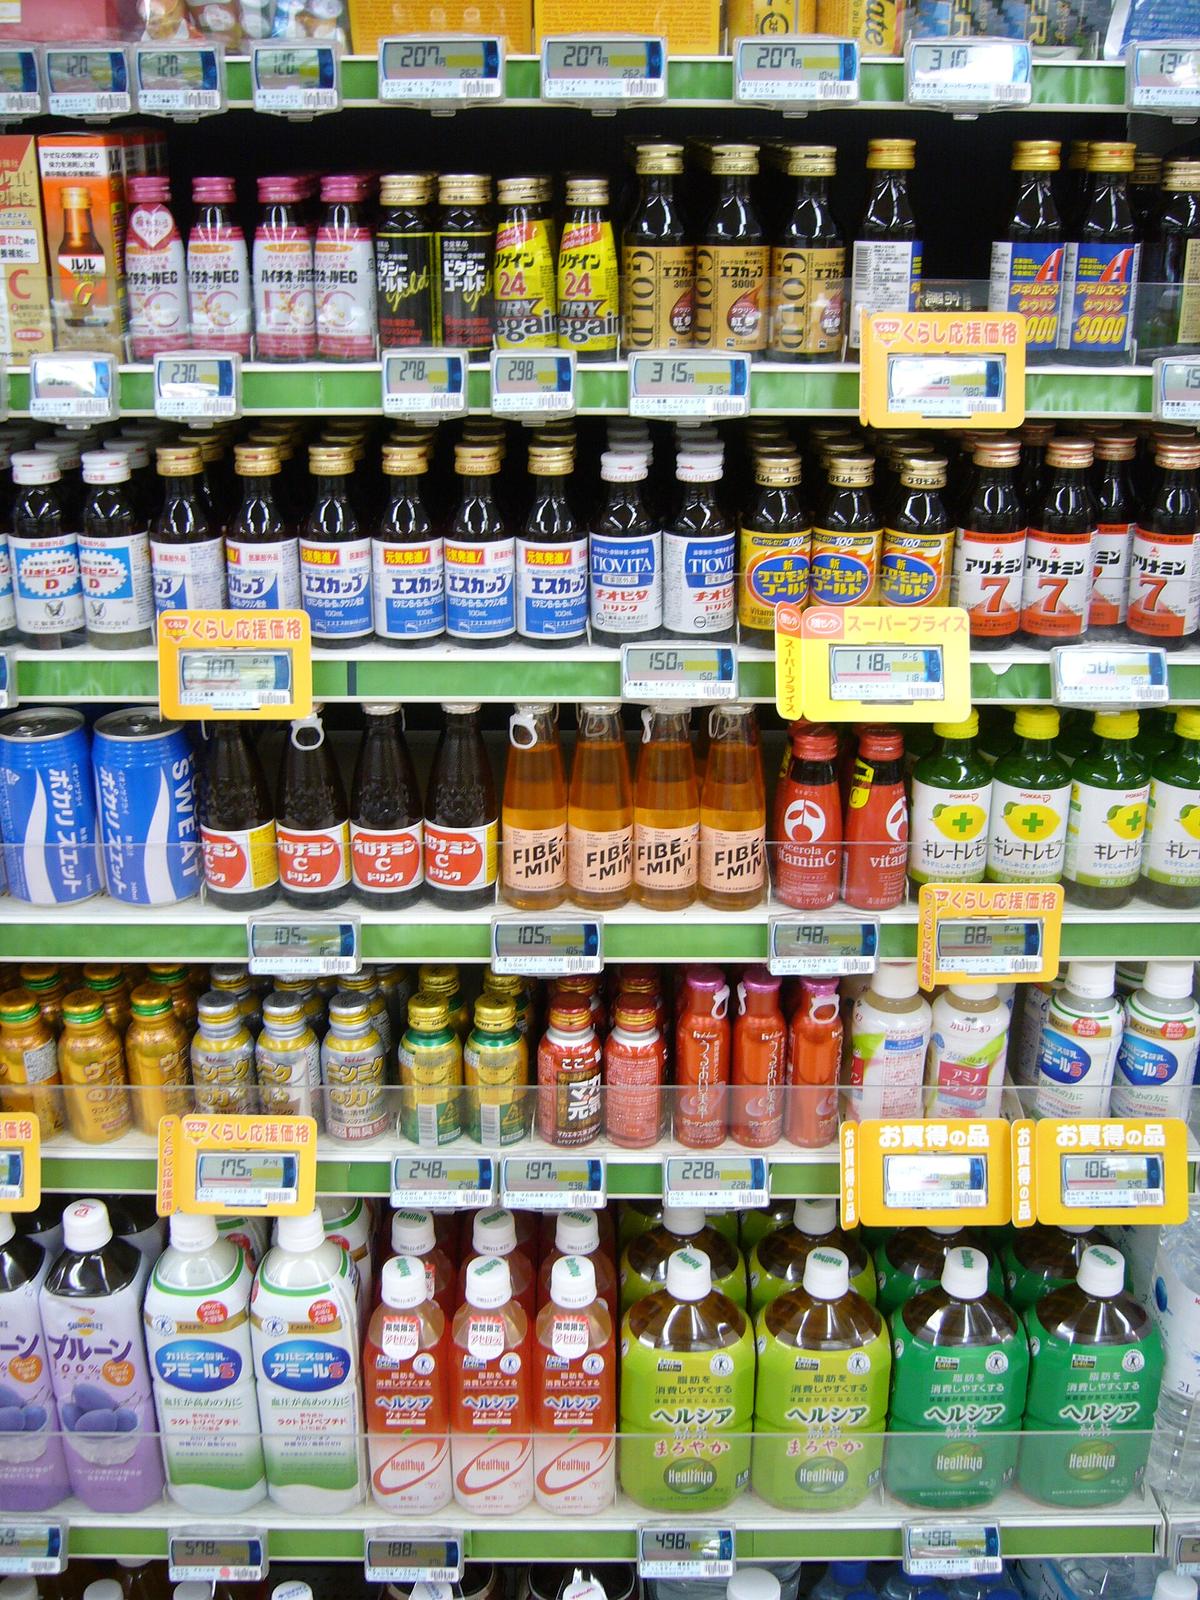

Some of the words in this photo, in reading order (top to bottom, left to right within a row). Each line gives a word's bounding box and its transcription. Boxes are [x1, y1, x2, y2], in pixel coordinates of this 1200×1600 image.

[71, 258, 96, 269] ルル
[444, 260, 485, 276] ビタシー
[498, 271, 526, 297] 24
[565, 271, 592, 297] 24
[903, 323, 1017, 345] くらし応援価格
[1073, 315, 1128, 345] 3000
[24, 565, 75, 577] リポビタン
[592, 554, 652, 573] TIOVITA
[965, 557, 1022, 576] アリナミン
[1027, 556, 1084, 576] アリナミン
[45, 579, 59, 590] D
[89, 579, 100, 589] D
[305, 574, 363, 594] エスカップ
[449, 574, 506, 594] エスカップ
[595, 590, 649, 601] チオビタ
[981, 576, 1010, 614] 7
[1037, 576, 1069, 614] 7
[1139, 574, 1168, 613] 7
[603, 604, 638, 612] ドリンク
[192, 620, 302, 640] くらし応援価格
[848, 616, 967, 632] スーパープライス
[784, 640, 795, 712] スーパープライス
[172, 758, 199, 877] SWEAT
[49, 768, 82, 894] ポカリスエット
[293, 857, 309, 871] C
[375, 857, 391, 871] C
[435, 853, 449, 867] C
[367, 871, 404, 883] ドリンク
[952, 892, 1056, 909] くらし応援価格
[952, 1068, 979, 1083] アミノ
[211, 1123, 310, 1143] くらし応援価格
[879, 1124, 990, 1147] お買得の品
[1056, 1124, 1166, 1147] お買得の品
[844, 1129, 855, 1223] お買得の品
[1017, 1127, 1031, 1222] お買得の品
[386, 1324, 415, 1332] 期間限定
[472, 1323, 501, 1332] 期間限定
[555, 1322, 586, 1331] 期間限定
[48, 1334, 132, 1363] プルーン
[162, 1362, 236, 1379] アミールS
[270, 1361, 344, 1379] アミールS
[953, 1374, 985, 1382] 脂肪を
[1089, 1372, 1121, 1381] 脂肪を
[677, 1376, 711, 1384] 脂肪を
[814, 1375, 847, 1383] 脂肪を
[1067, 1382, 1140, 1392] 消費しやすくする
[656, 1386, 732, 1394] 消費しやすくする
[792, 1385, 868, 1393] 消費しやすくする
[931, 1384, 1004, 1394] 消費しやすくする
[376, 1395, 433, 1411] ヘルシア
[463, 1395, 519, 1411] ヘルシア
[544, 1395, 601, 1411] ヘルシア
[652, 1407, 734, 1425] ヘルシア
[786, 1406, 869, 1424] ヘルシア
[925, 1404, 1005, 1424] ヘルシア
[1060, 1402, 1140, 1422] ヘルシア
[655, 1440, 730, 1457] まろやか
[786, 1440, 863, 1457] まろやか
[936, 1455, 983, 1471] Healthya
[1069, 1453, 1116, 1470] Healthya
[669, 1470, 713, 1485] Healthya
[800, 1469, 845, 1484] Healthya
